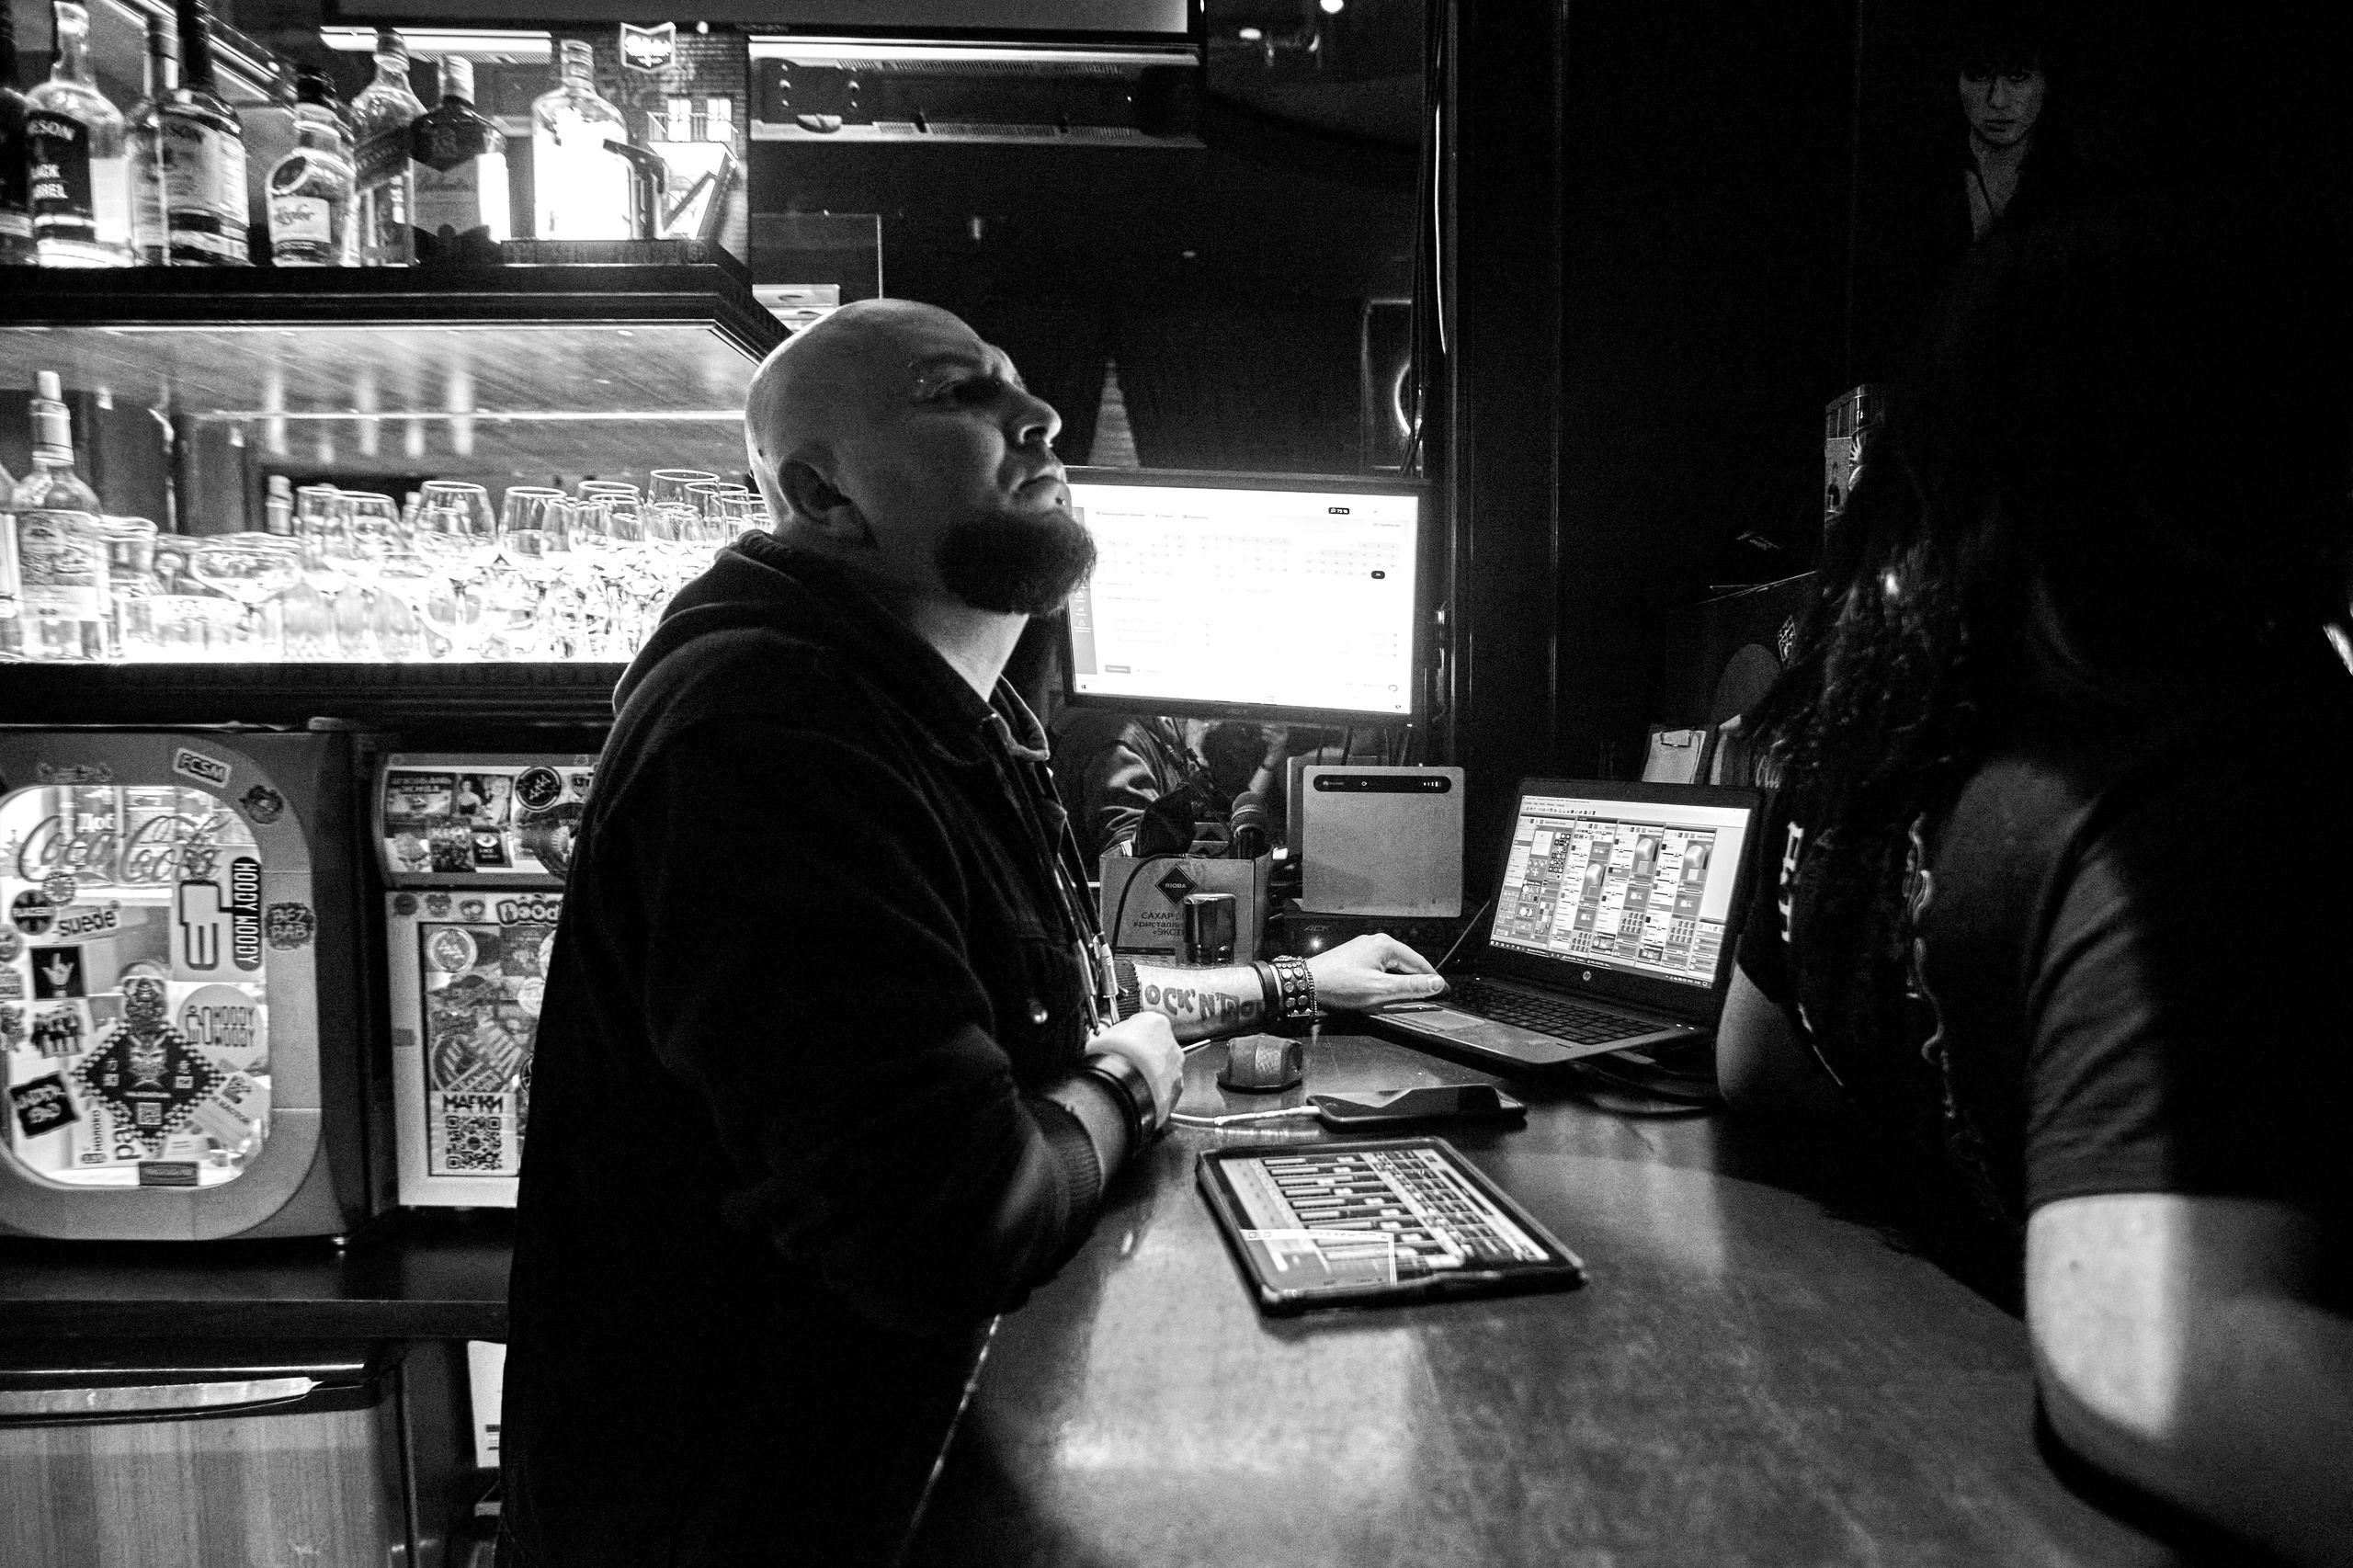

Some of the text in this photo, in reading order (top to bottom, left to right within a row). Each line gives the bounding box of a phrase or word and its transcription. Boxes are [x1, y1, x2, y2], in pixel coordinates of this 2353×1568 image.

[59, 910, 117, 937] suede
[233, 862, 259, 964] HOODY WOODY
[1141, 912, 1174, 920] САХАР
